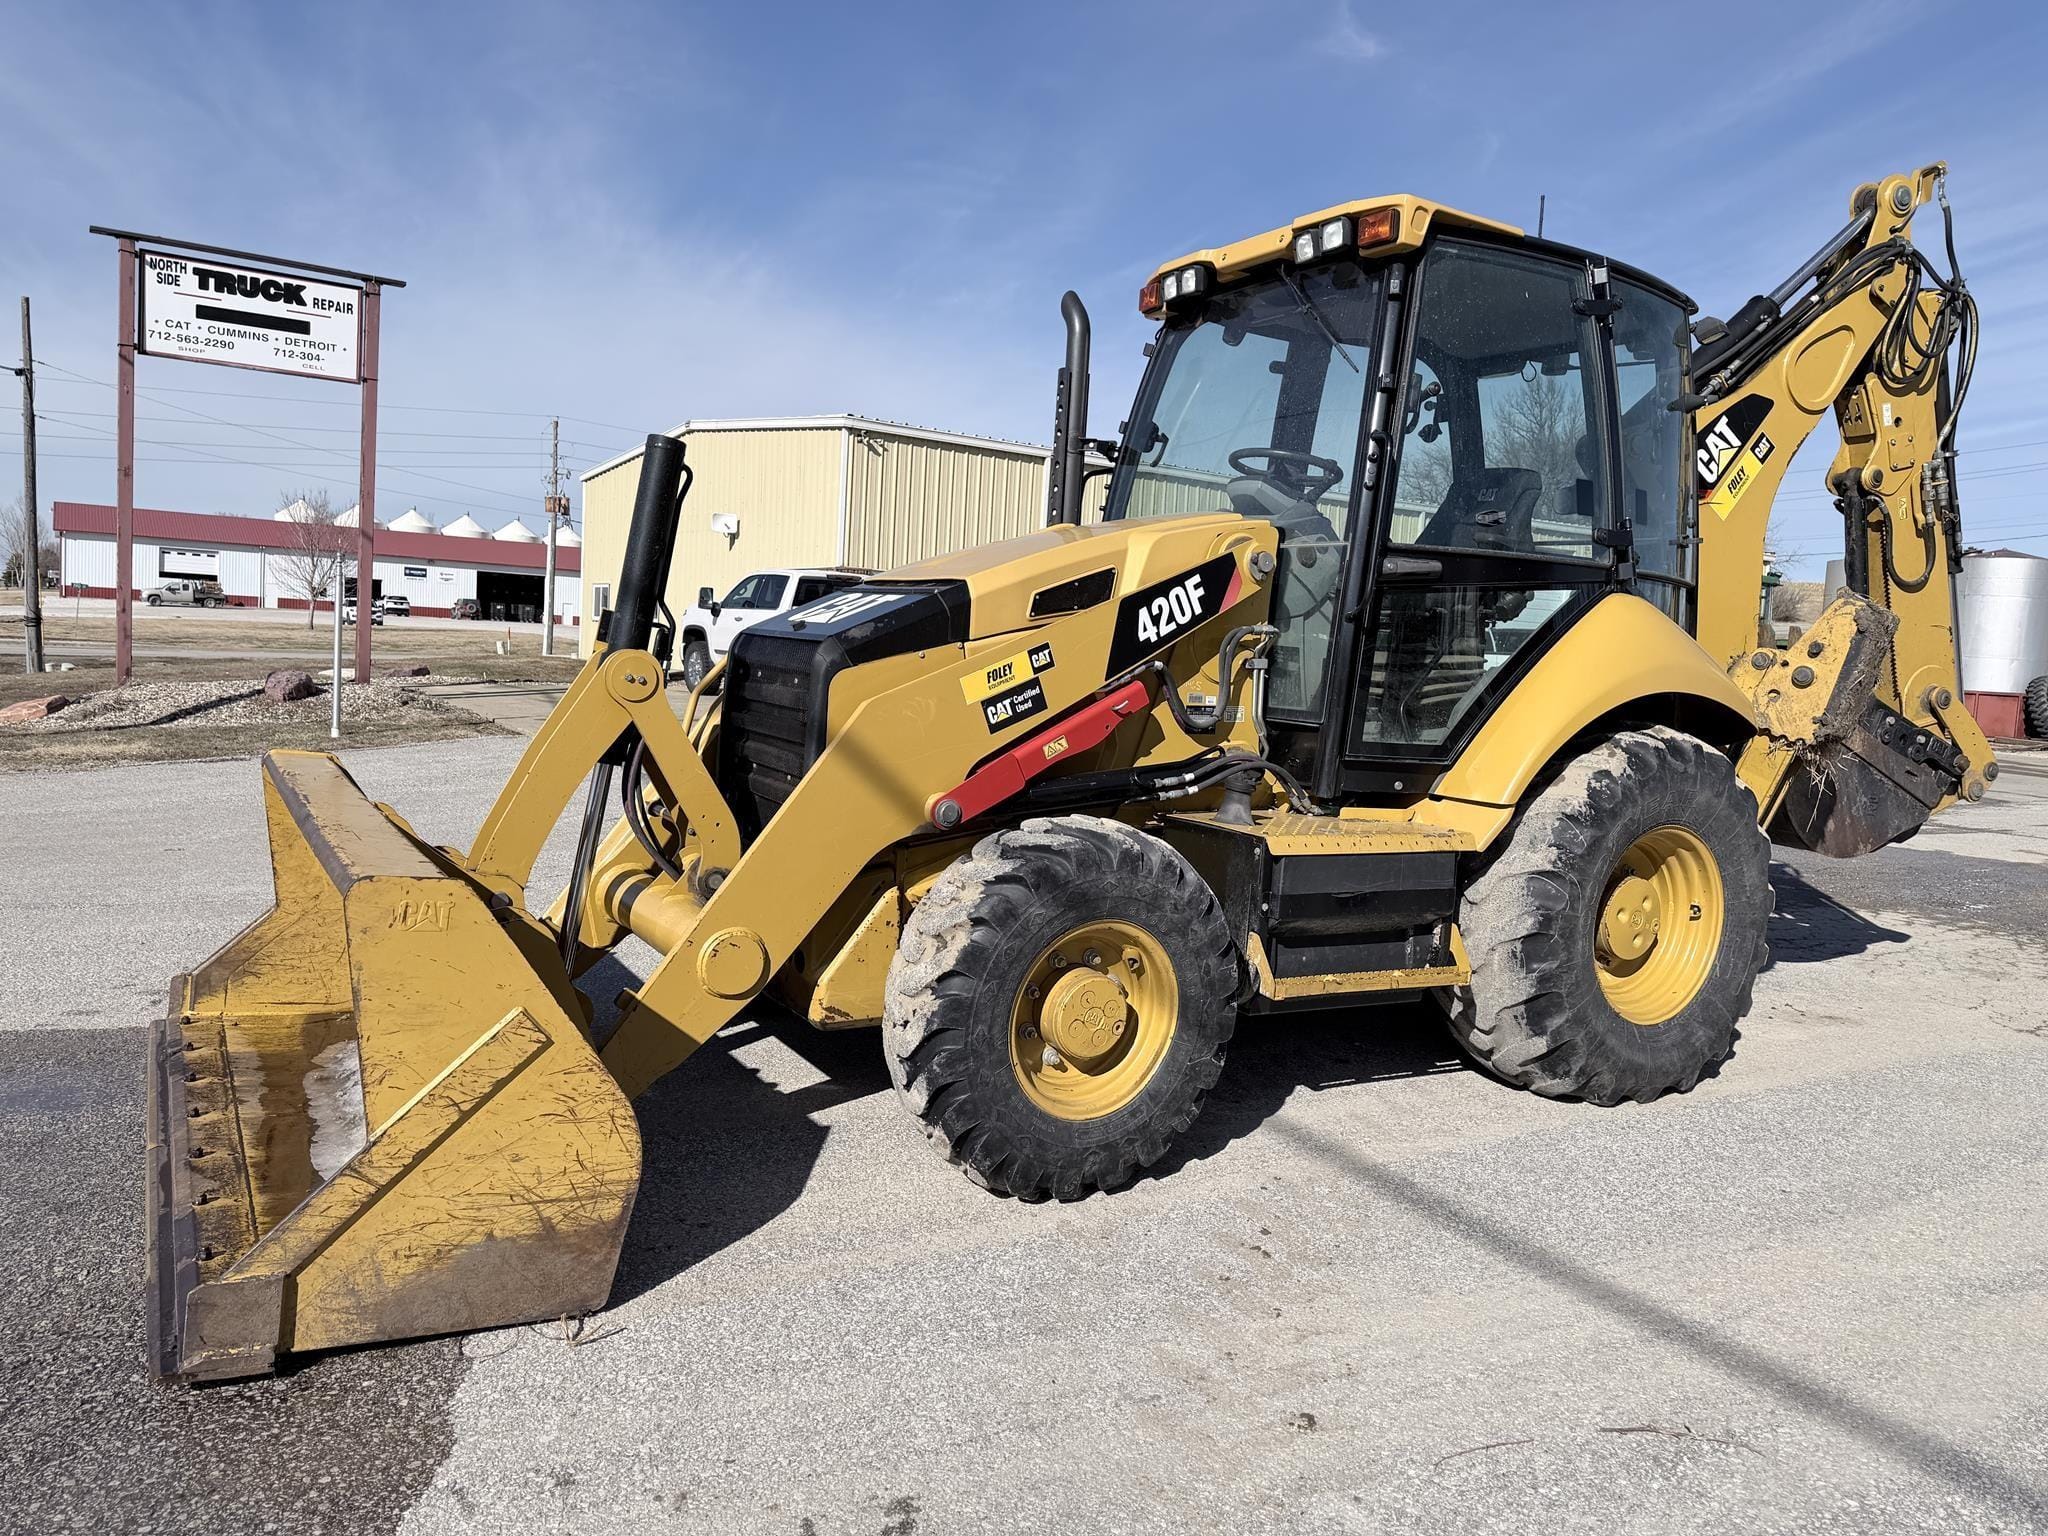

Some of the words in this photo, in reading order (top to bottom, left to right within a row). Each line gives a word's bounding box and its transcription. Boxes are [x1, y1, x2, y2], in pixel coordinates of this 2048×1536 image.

[149, 257, 187, 275] NORTH
[156, 272, 181, 287] SIDE
[192, 267, 307, 307] TRUCK
[312, 297, 354, 315] REPAIR
[148, 329, 235, 350] 712-563-2290
[164, 319, 192, 331] CAT
[207, 325, 270, 343] CUMMINS
[284, 336, 338, 353] DETROIT
[178, 346, 206, 354] SHOP
[273, 347, 326, 362] 712-304-
[302, 363, 326, 371] CELL
[1697, 414, 1742, 484] CAT
[1754, 437, 1771, 459] CAT
[1727, 465, 1747, 495] FOLEY
[788, 592, 907, 624] CAT
[1137, 573, 1206, 643] 420F
[1031, 648, 1051, 668] CAT
[986, 661, 1014, 684] FOLEY
[987, 699, 1013, 724] CAT
[1013, 685, 1041, 704] Certified
[1015, 698, 1033, 713] Used
[398, 899, 456, 932] CAT
